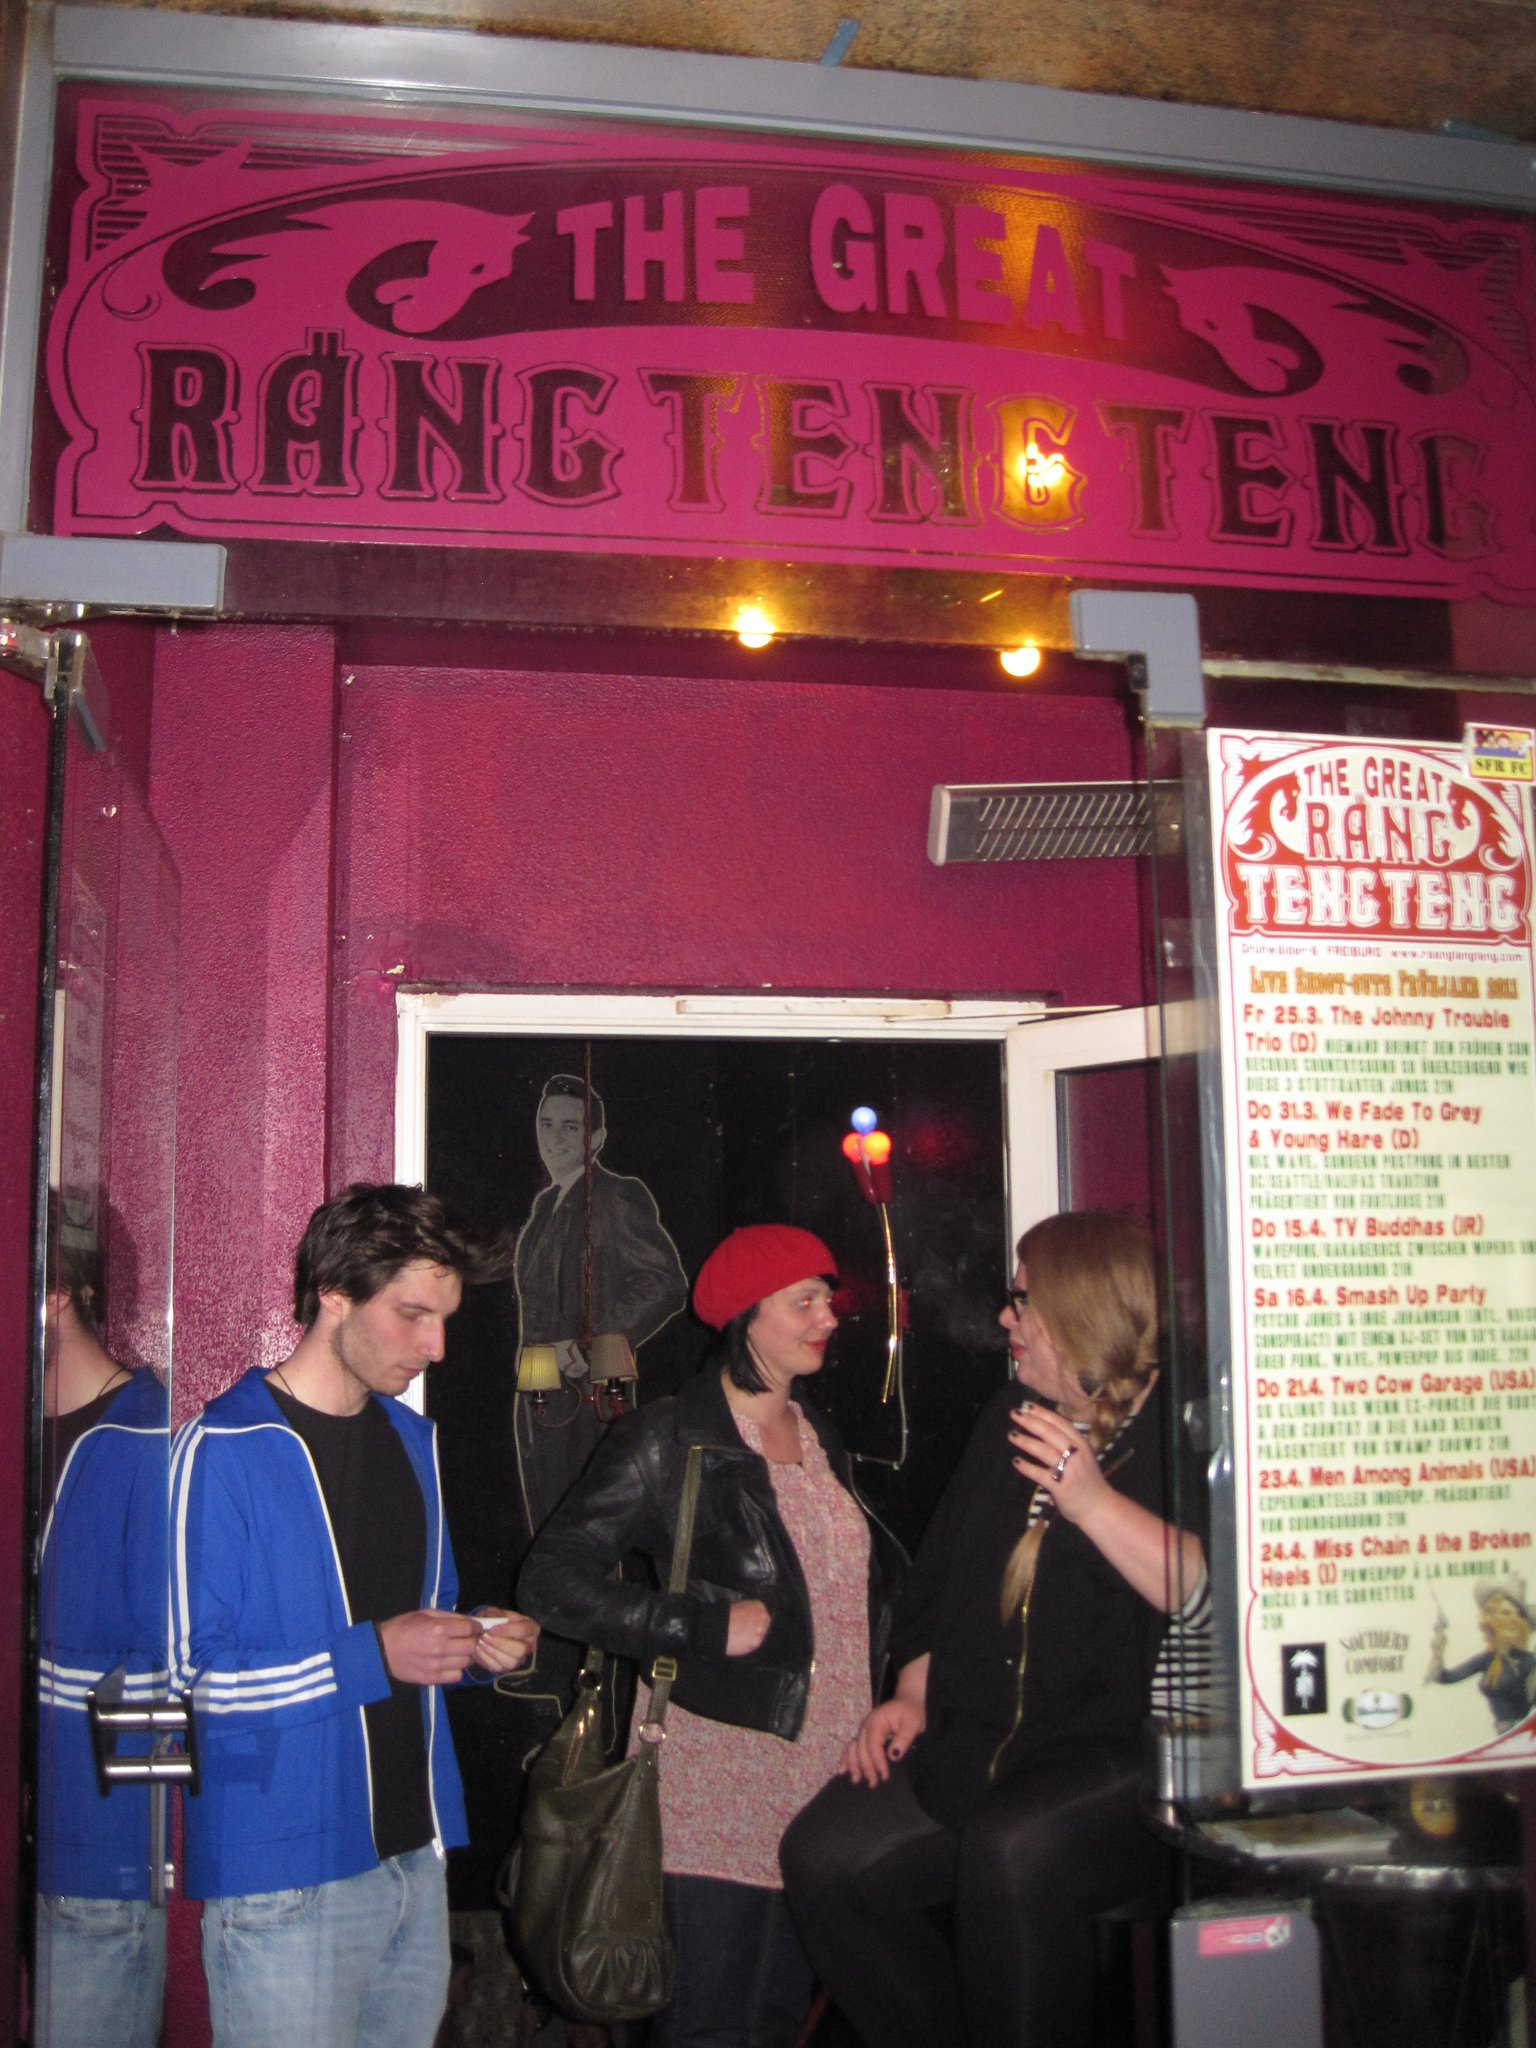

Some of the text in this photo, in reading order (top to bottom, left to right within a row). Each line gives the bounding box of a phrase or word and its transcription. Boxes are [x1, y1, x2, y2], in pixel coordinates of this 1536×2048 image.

[556, 183, 1137, 341] THE GREAT
[1303, 755, 1443, 804] THE GREAT
[1243, 1004, 1510, 1030] Fr 25.3. The Johnny Trouble
[1245, 1031, 1282, 1052] Trio
[1290, 1031, 1317, 1053] (D)
[1248, 1100, 1482, 1126] Do 31.3. We Fade To Grey
[1249, 1127, 1420, 1152] & Young Hare (D)
[1252, 1217, 1276, 1238] Do
[1334, 1217, 1357, 1237] TV
[1366, 1216, 1444, 1237] Buddhas
[1254, 1284, 1487, 1308] Sa 16.4. Smash Up Party
[1257, 1378, 1280, 1399] Do
[1332, 1376, 1368, 1396] Two
[1375, 1374, 1412, 1394] Cow
[1421, 1373, 1484, 1396] Garage
[1259, 1469, 1302, 1489] 23.4.
[1310, 1466, 1344, 1487] Men
[1353, 1465, 1411, 1488] Among
[1419, 1461, 1483, 1482] Animals
[1261, 1530, 1531, 1563] 24.4. Miss Chain & the Broken
[1261, 1567, 1310, 1588] Heels
